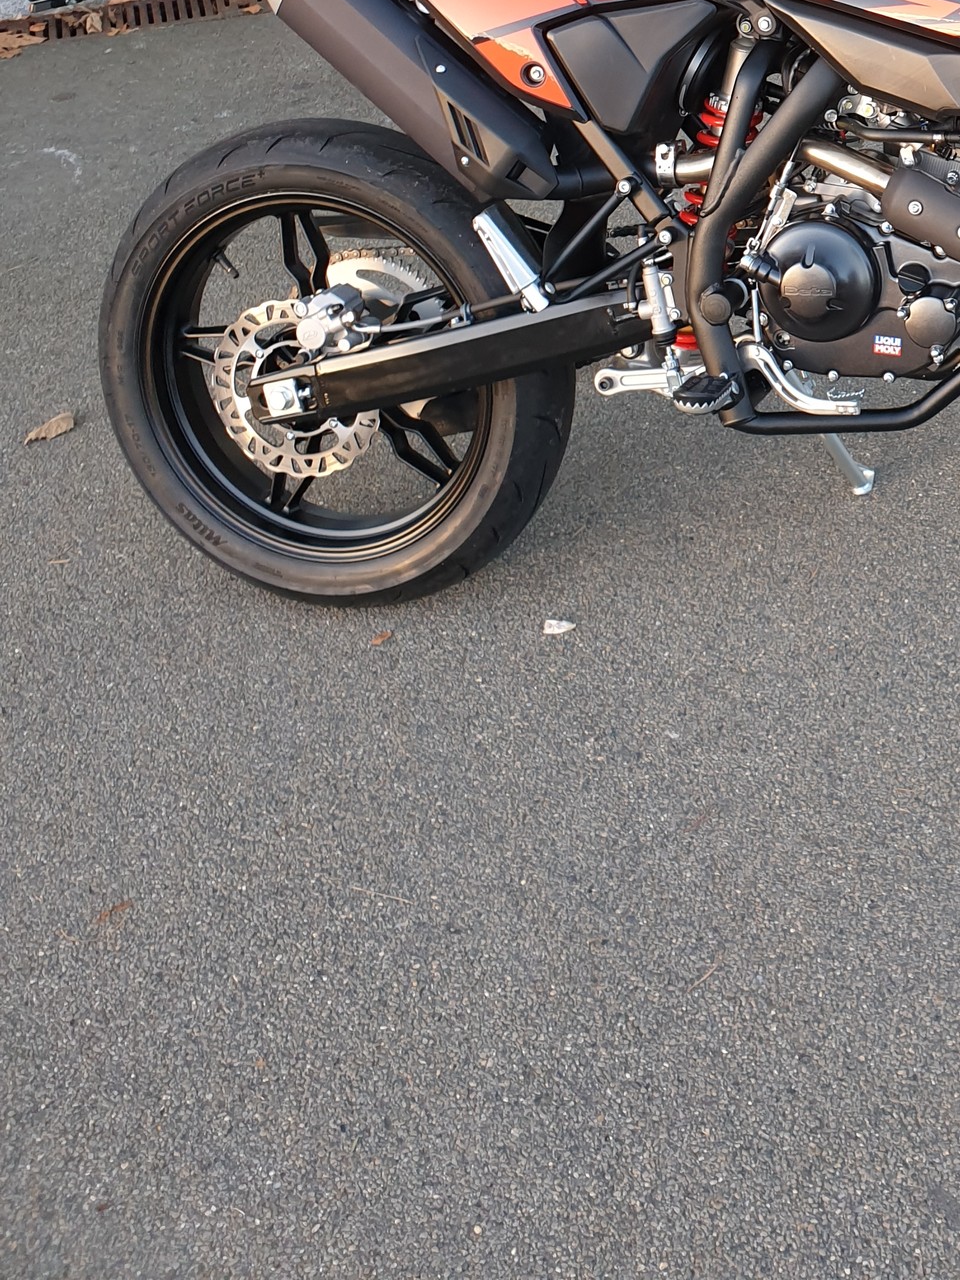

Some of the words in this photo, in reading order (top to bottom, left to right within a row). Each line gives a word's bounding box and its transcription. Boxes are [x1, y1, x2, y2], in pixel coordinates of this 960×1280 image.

[131, 209, 181, 276] SPORT
[874, 335, 902, 347] LIQUI
[873, 344, 902, 356] MOLY
